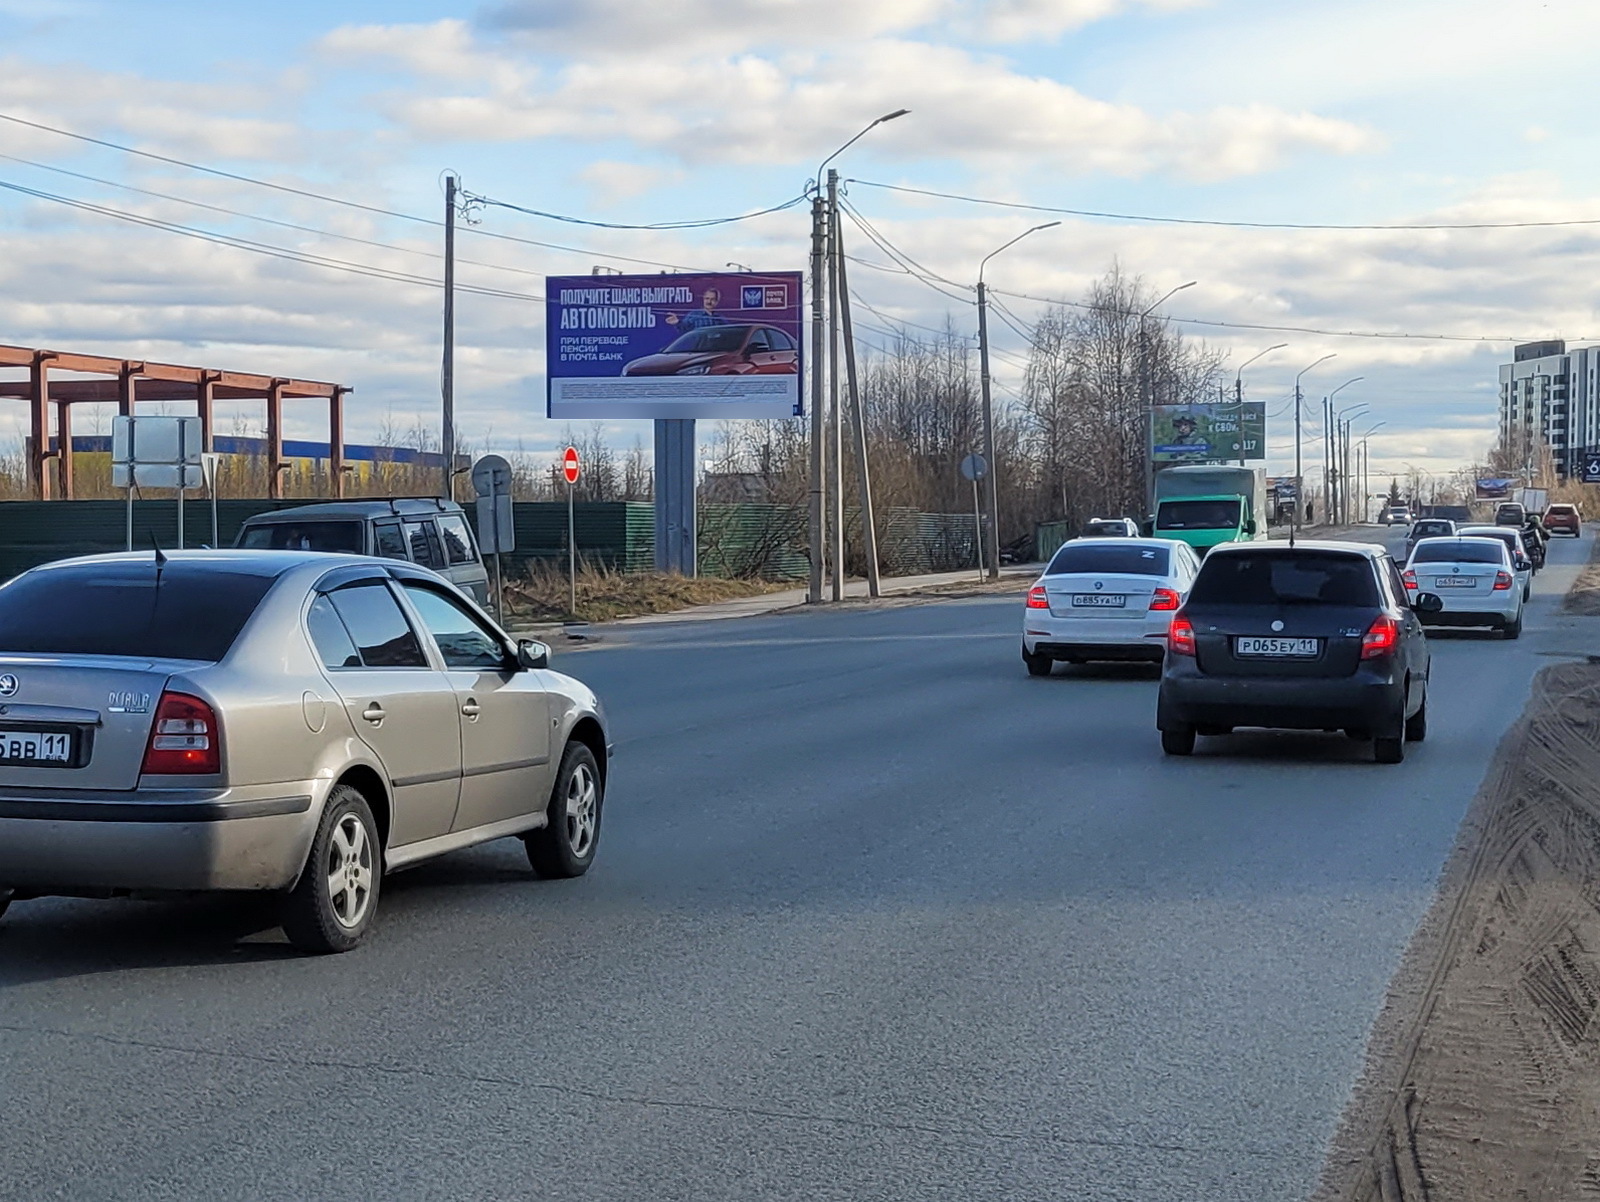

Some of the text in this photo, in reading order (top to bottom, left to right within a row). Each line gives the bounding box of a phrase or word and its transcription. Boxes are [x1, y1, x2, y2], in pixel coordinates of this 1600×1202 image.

[560, 286, 693, 305] ПОЛУЧИТЕ ШАНС ВЫИГРАТЬ
[560, 307, 656, 330] АВТОМОБИЛЬ
[560, 336, 629, 345] ПРИ ПЕРЕВОДЕ
[560, 345, 598, 353] ПЕНСИИ
[568, 353, 597, 361] ПОЧТА
[599, 353, 623, 361] БАНК
[1300, 640, 1314, 650] 11
[44, 735, 66, 755] 11
